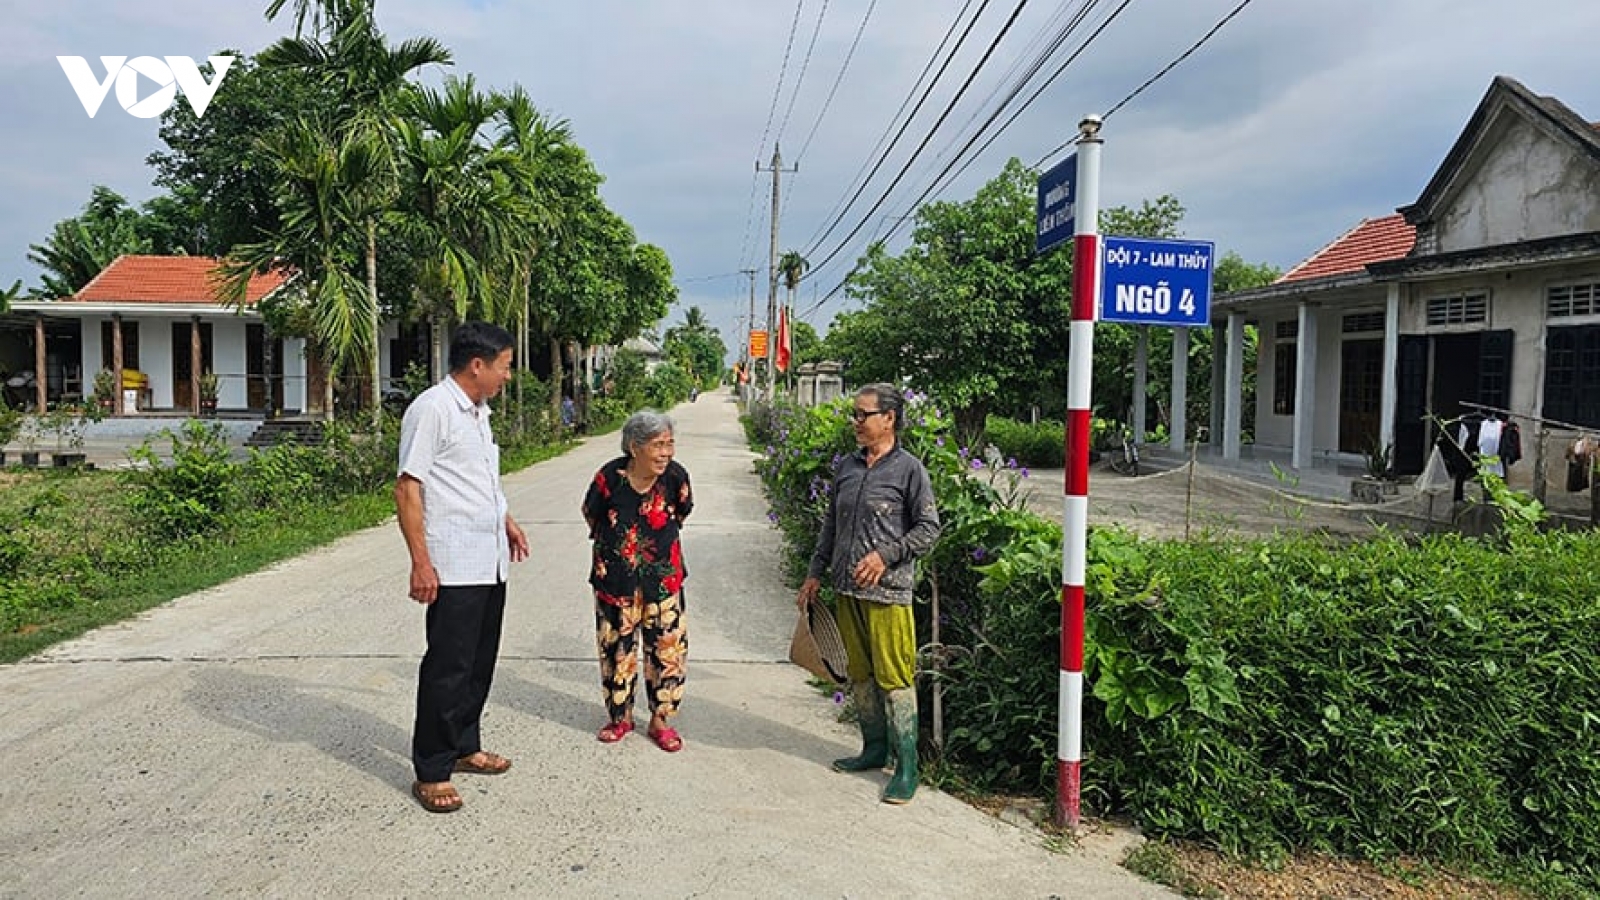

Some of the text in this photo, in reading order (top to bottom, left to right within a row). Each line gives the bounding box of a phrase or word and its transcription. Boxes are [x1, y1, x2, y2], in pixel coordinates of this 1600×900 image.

[1107, 246, 1130, 268] ĐỘI
[1133, 251, 1140, 265] 7
[1150, 251, 1175, 267] LAM
[1179, 250, 1208, 269] THỦY
[1116, 280, 1196, 316] NGÕ 4
